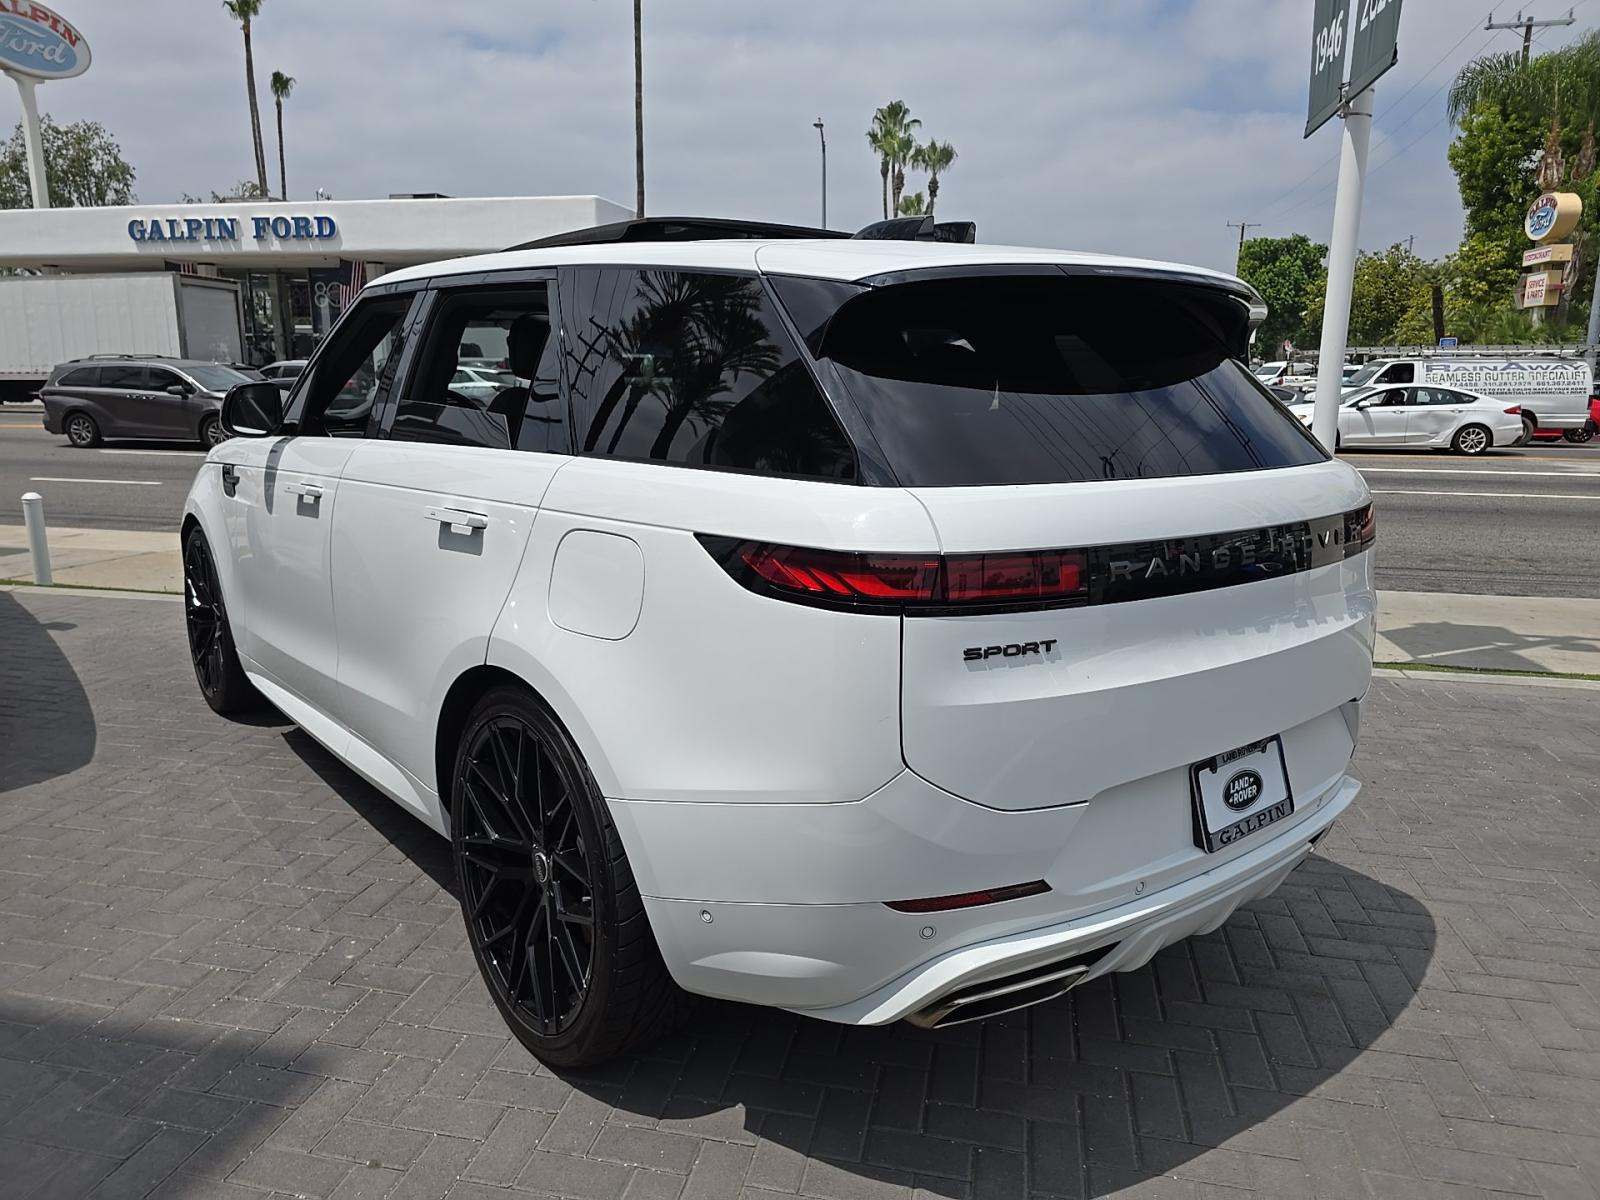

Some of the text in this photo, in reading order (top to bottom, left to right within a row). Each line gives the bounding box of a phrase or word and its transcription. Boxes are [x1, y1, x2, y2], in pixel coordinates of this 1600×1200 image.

[1315, 9, 1344, 76] 1946
[128, 216, 337, 241] GALPIN FORD
[1108, 543, 1256, 584] RANGE
[963, 638, 1058, 661] SPORT
[1230, 776, 1249, 794] LAND
[1233, 784, 1258, 805] ROVER
[1218, 802, 1286, 845] GALPIN
